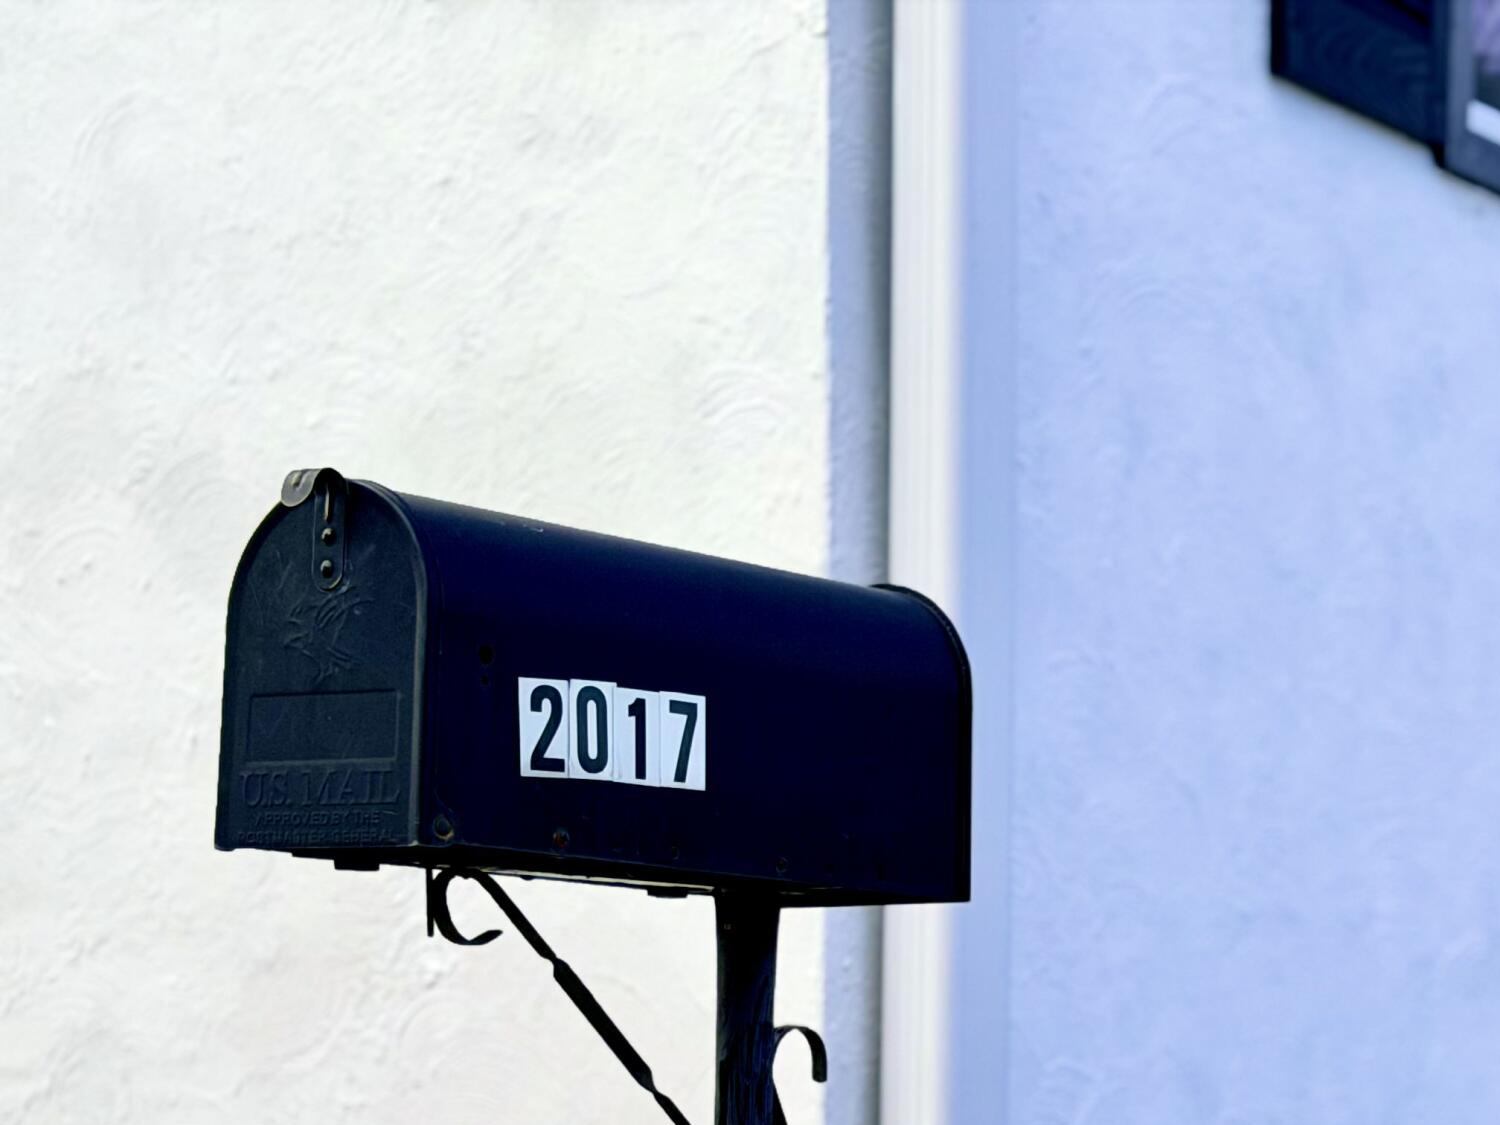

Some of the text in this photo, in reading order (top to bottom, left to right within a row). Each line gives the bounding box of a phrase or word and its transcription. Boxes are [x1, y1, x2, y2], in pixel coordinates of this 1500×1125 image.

[530, 684, 698, 784] 2017
[239, 768, 401, 808] U.S. MAIL
[254, 811, 328, 828] APPROVED
[352, 809, 381, 826] THE
